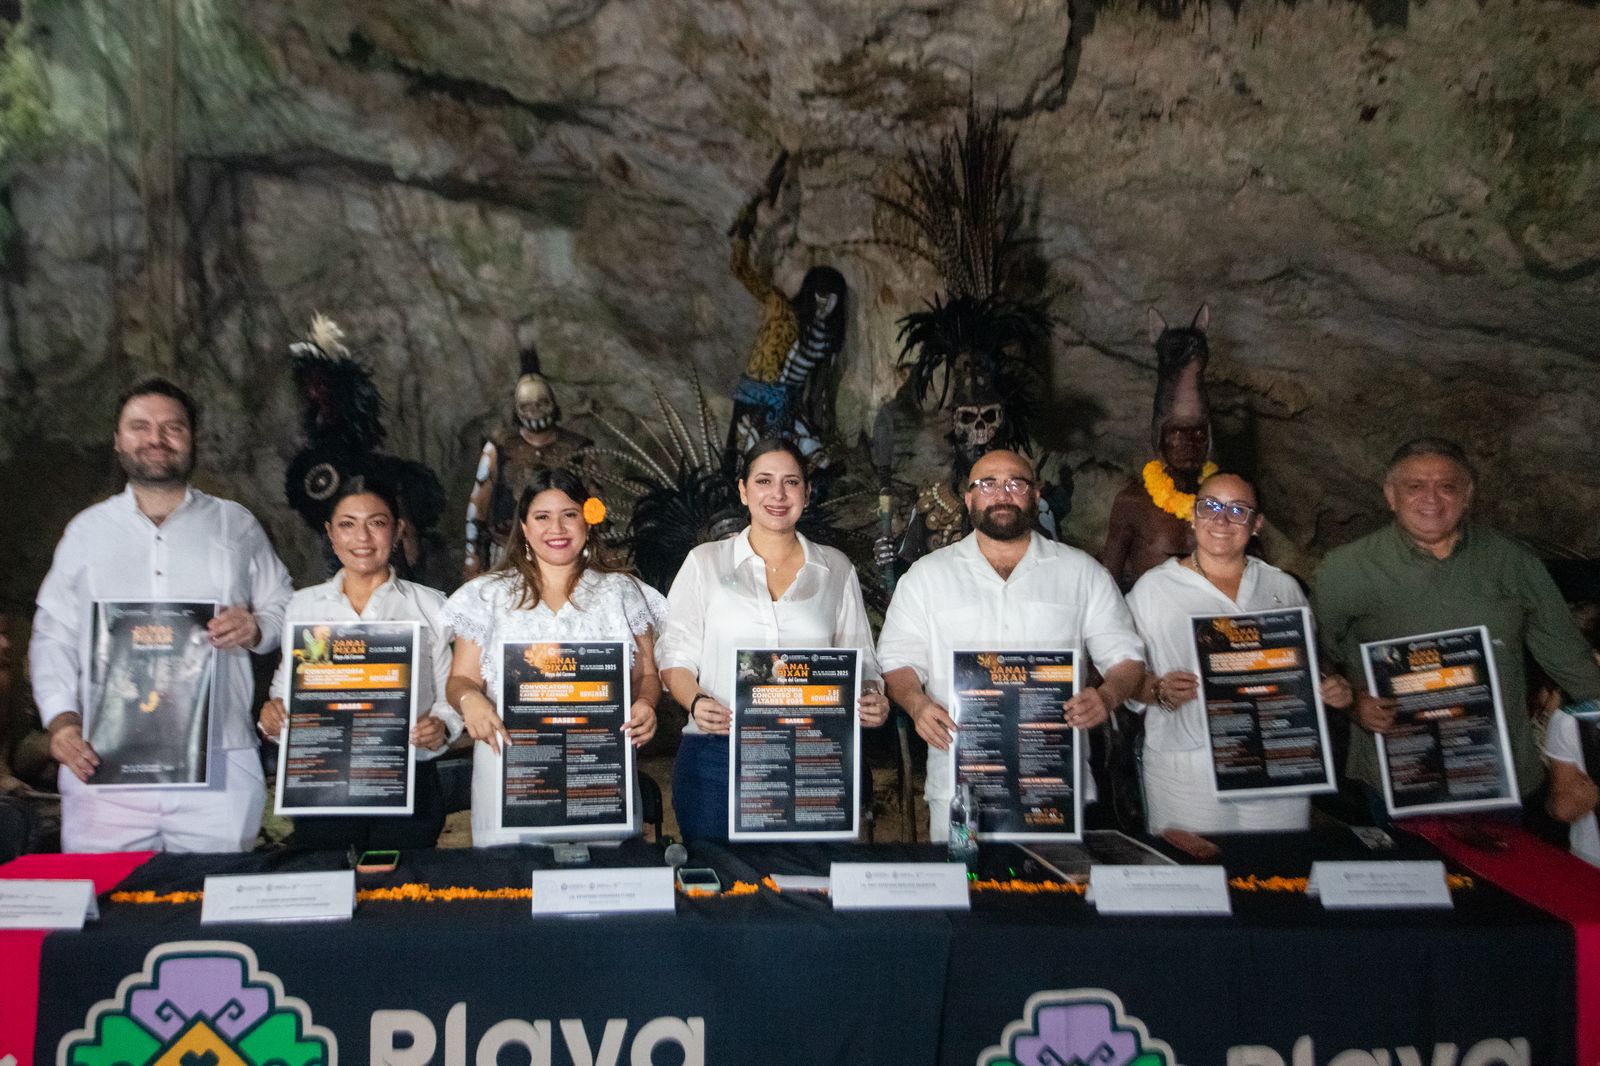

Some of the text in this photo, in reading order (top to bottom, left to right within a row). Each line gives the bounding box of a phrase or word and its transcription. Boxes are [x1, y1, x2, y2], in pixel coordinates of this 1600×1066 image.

[991, 665, 1027, 674] JANAL
[991, 673, 1027, 682] PIXAN
[370, 1001, 705, 1066] Playa
